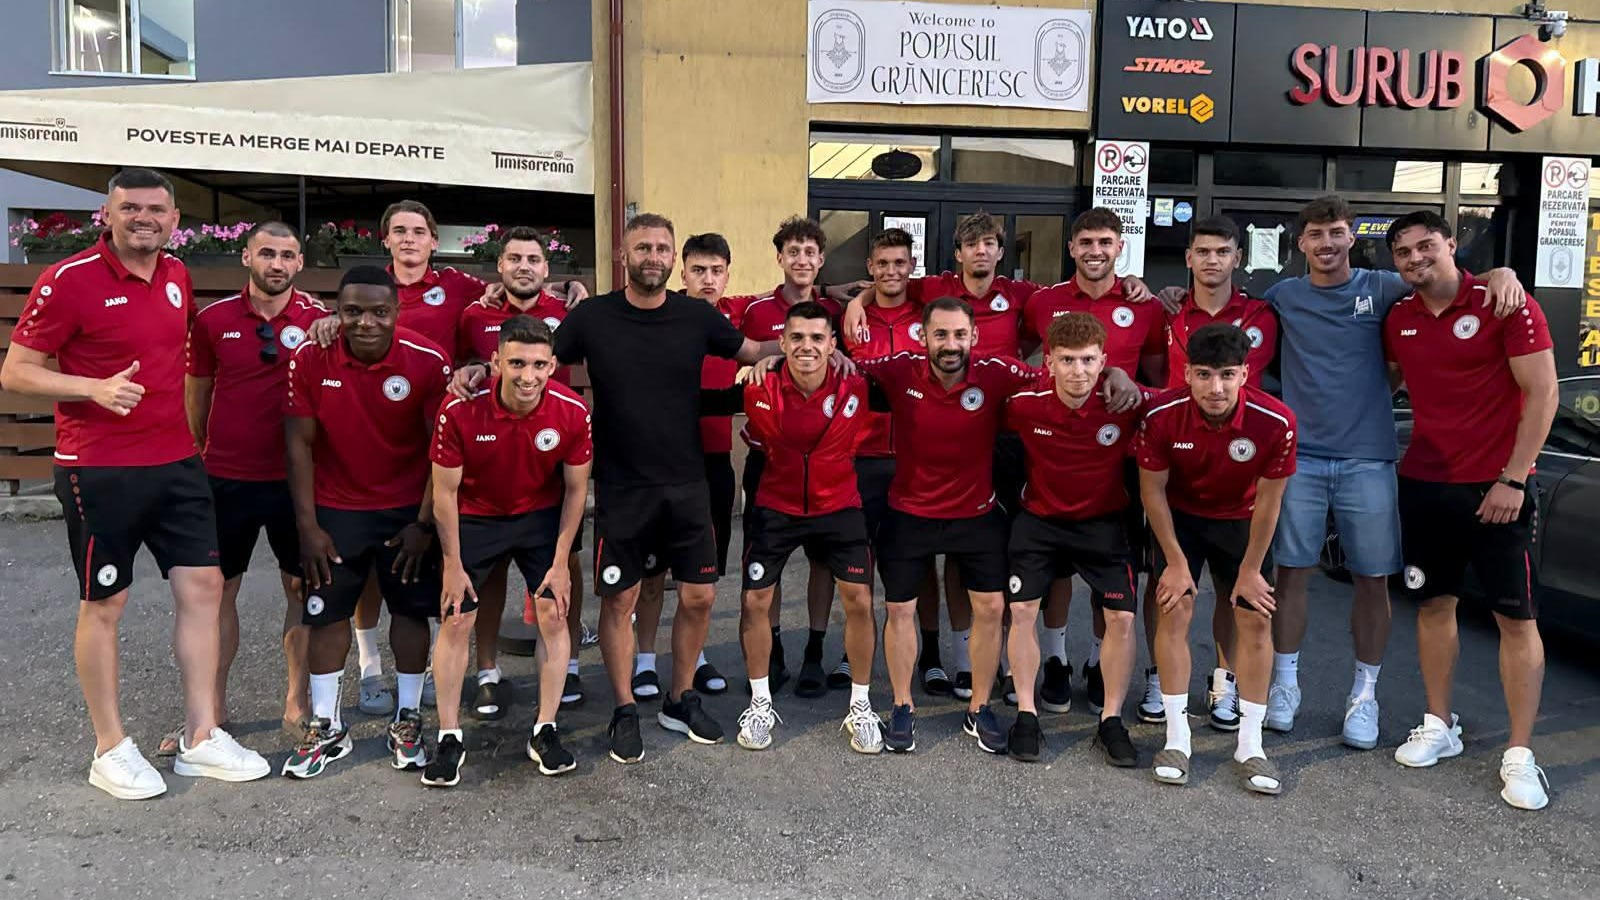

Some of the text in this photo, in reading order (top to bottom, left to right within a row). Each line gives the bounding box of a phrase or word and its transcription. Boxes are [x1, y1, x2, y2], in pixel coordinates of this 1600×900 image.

[909, 12, 995, 28] Welcome to
[1126, 16, 1188, 39] YATO
[900, 31, 1001, 62] POPASUL
[1123, 57, 1213, 75] STHOR
[871, 62, 1028, 98] GRĂNICERESC
[1290, 42, 1467, 109] SURUB
[1121, 96, 1189, 115] VOREL
[126, 128, 445, 160] POVESTEA MERGE MAI DEPARTE
[1101, 175, 1141, 186] PARCARE
[1096, 186, 1145, 197] REZERVATA
[1547, 190, 1583, 200] PARCARE
[1102, 198, 1137, 206] EXCLUSIV
[1542, 200, 1587, 211] REZERVATA
[1548, 228, 1577, 237] POPASUL
[1540, 237, 1585, 247] GRANICERESC
[105, 296, 128, 307] JAKO
[321, 378, 342, 388] JAKO
[906, 388, 924, 399] JAKO
[1033, 427, 1053, 436] JAKO
[475, 434, 497, 442] JAKO
[1172, 442, 1194, 450] JAKO
[1104, 592, 1124, 600] JAKO
